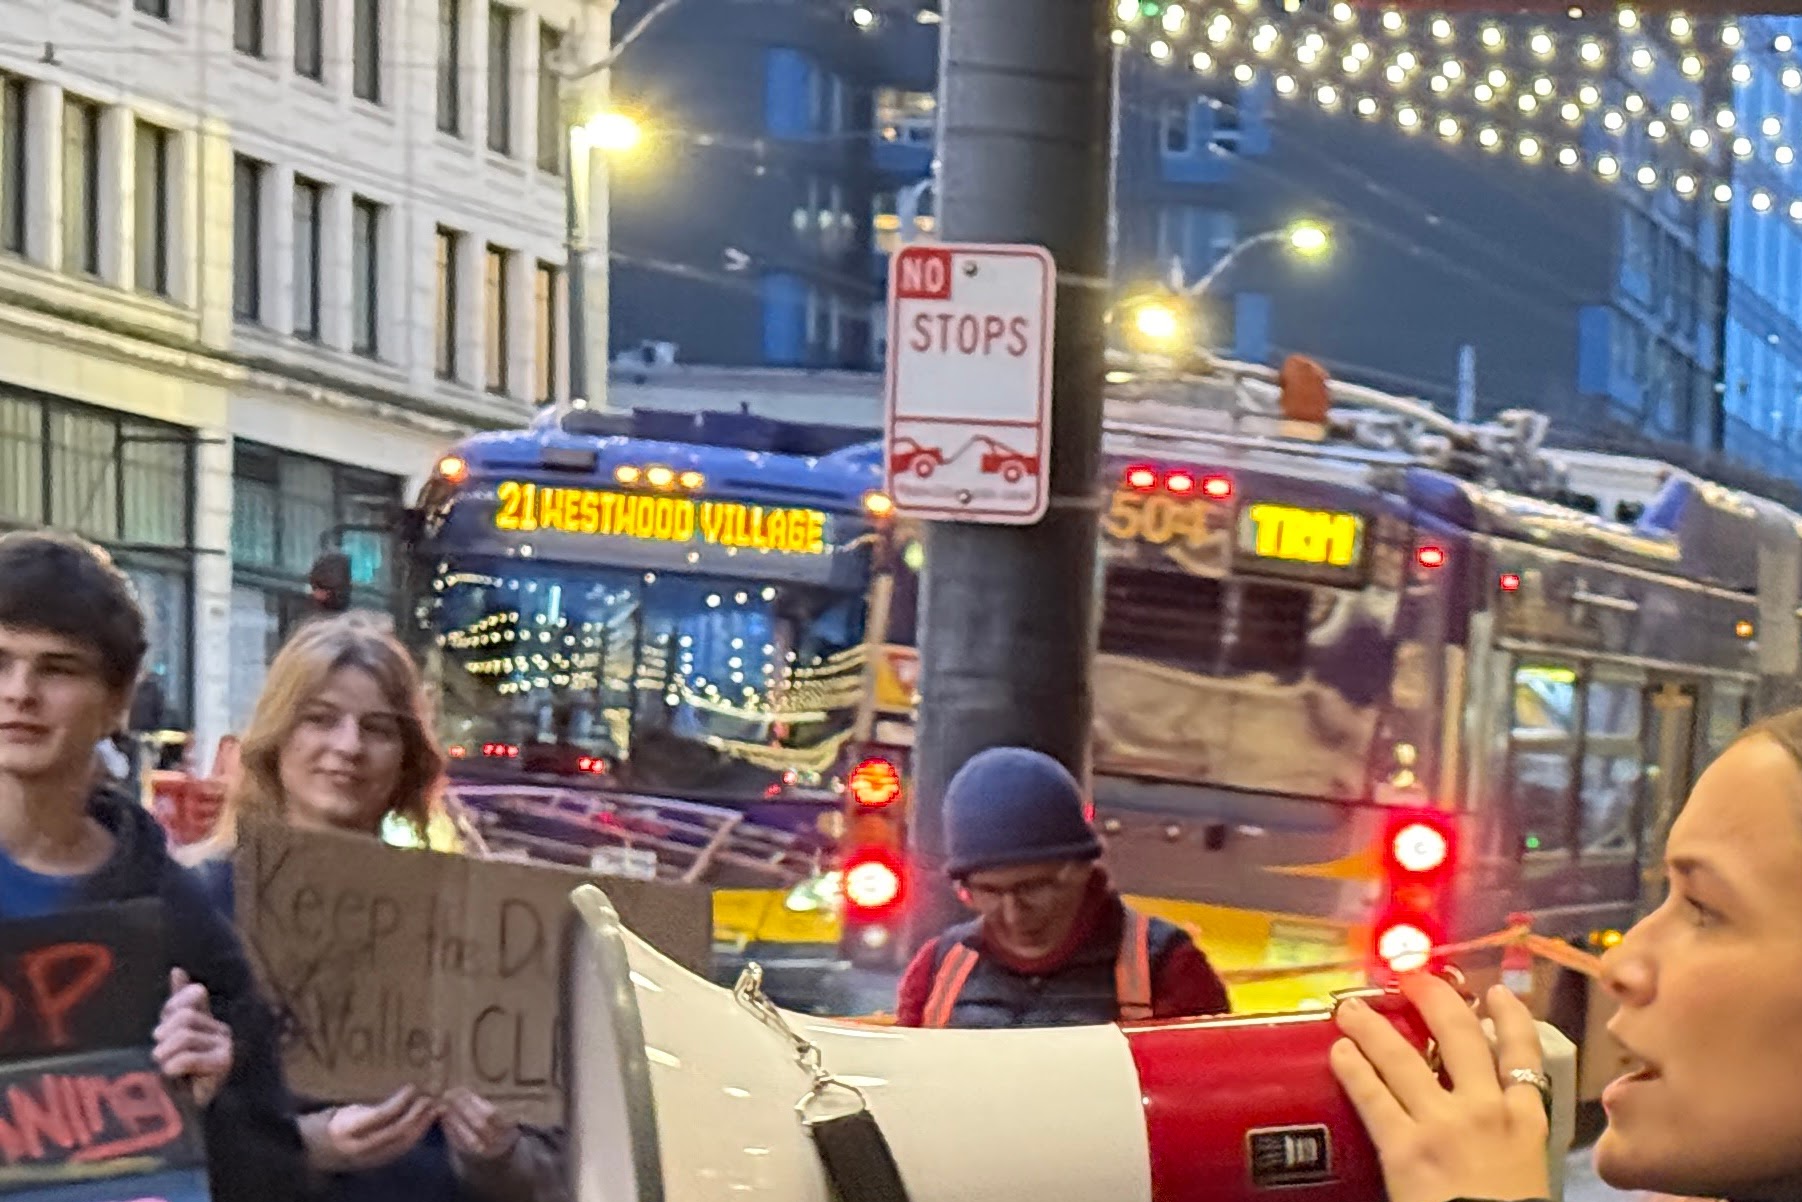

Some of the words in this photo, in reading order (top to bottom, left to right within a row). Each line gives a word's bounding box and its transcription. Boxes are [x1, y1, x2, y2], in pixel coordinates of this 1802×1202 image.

[901, 257, 945, 293] NO
[911, 312, 1028, 357] STOPS
[496, 481, 537, 530] 21
[541, 488, 694, 541] WESTWOOD
[701, 502, 826, 554] VILLAGE
[255, 836, 399, 968] Keep
